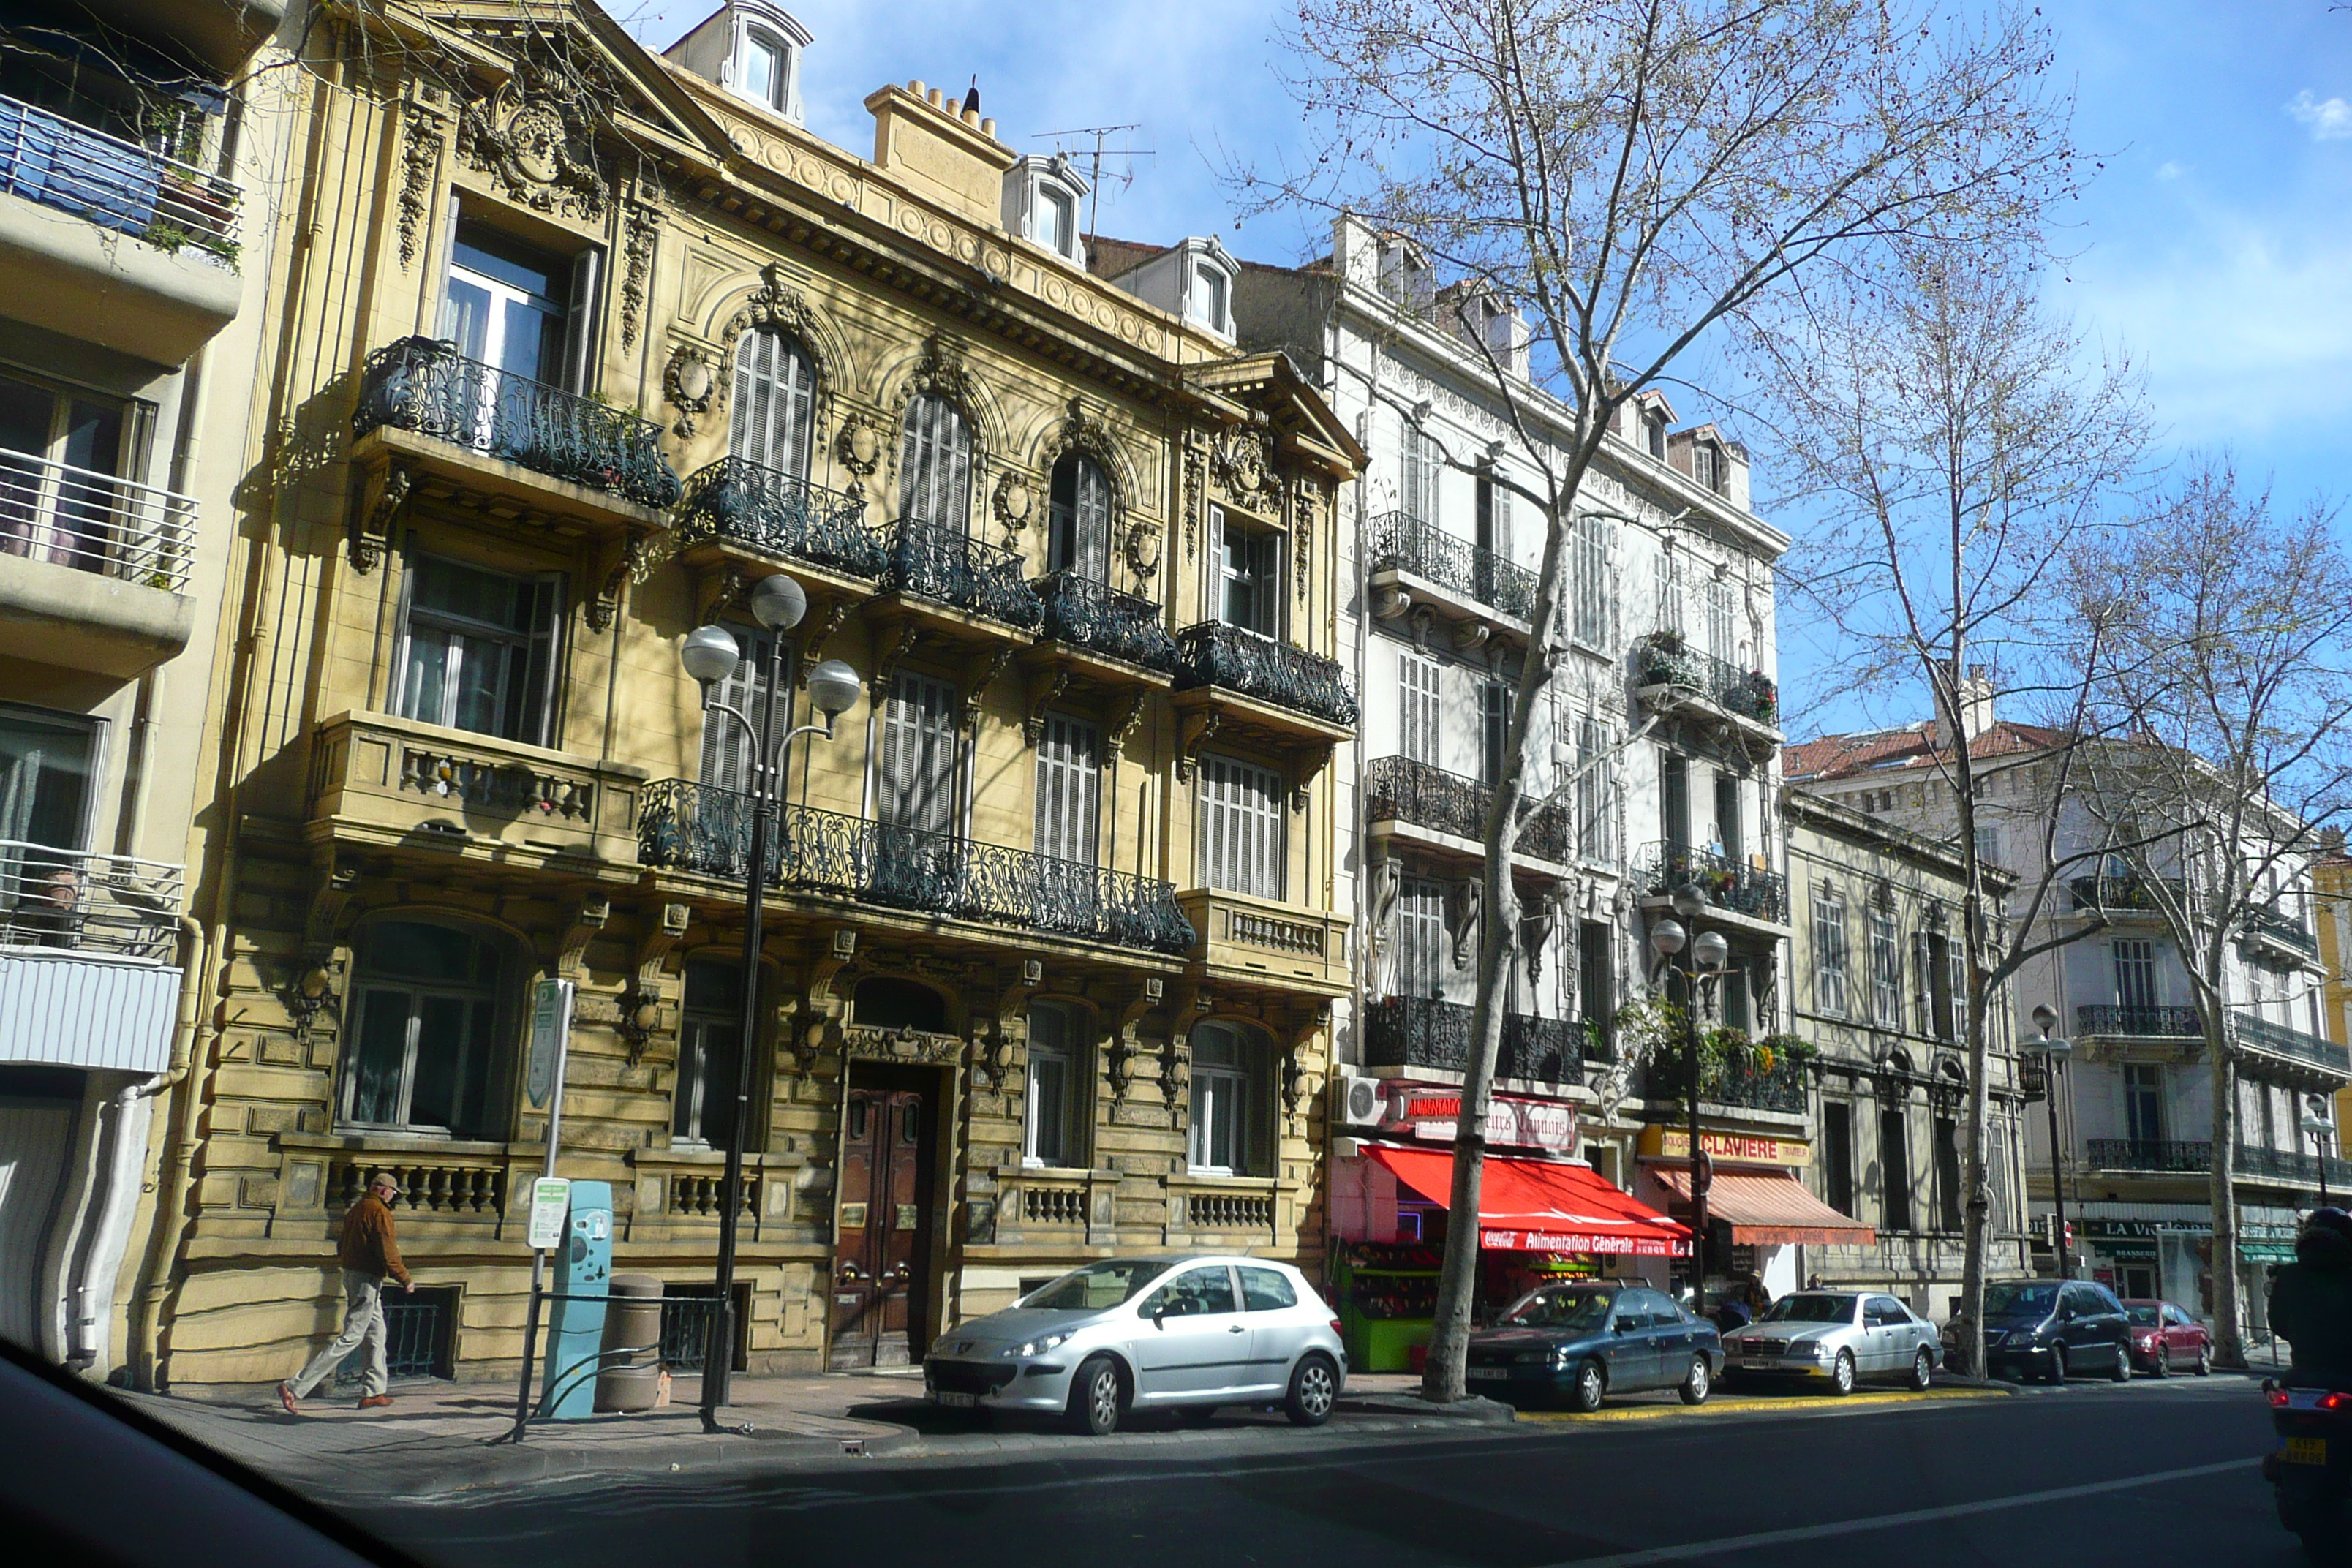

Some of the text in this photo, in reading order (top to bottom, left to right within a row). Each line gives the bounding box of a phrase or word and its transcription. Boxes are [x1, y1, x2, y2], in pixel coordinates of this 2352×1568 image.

[1701, 1135, 1778, 1159] CLAVIERE
[1782, 1146, 1808, 1158] TRAITEUR
[2106, 1223, 2127, 1236] LA
[1526, 1232, 1590, 1252] Alimentation
